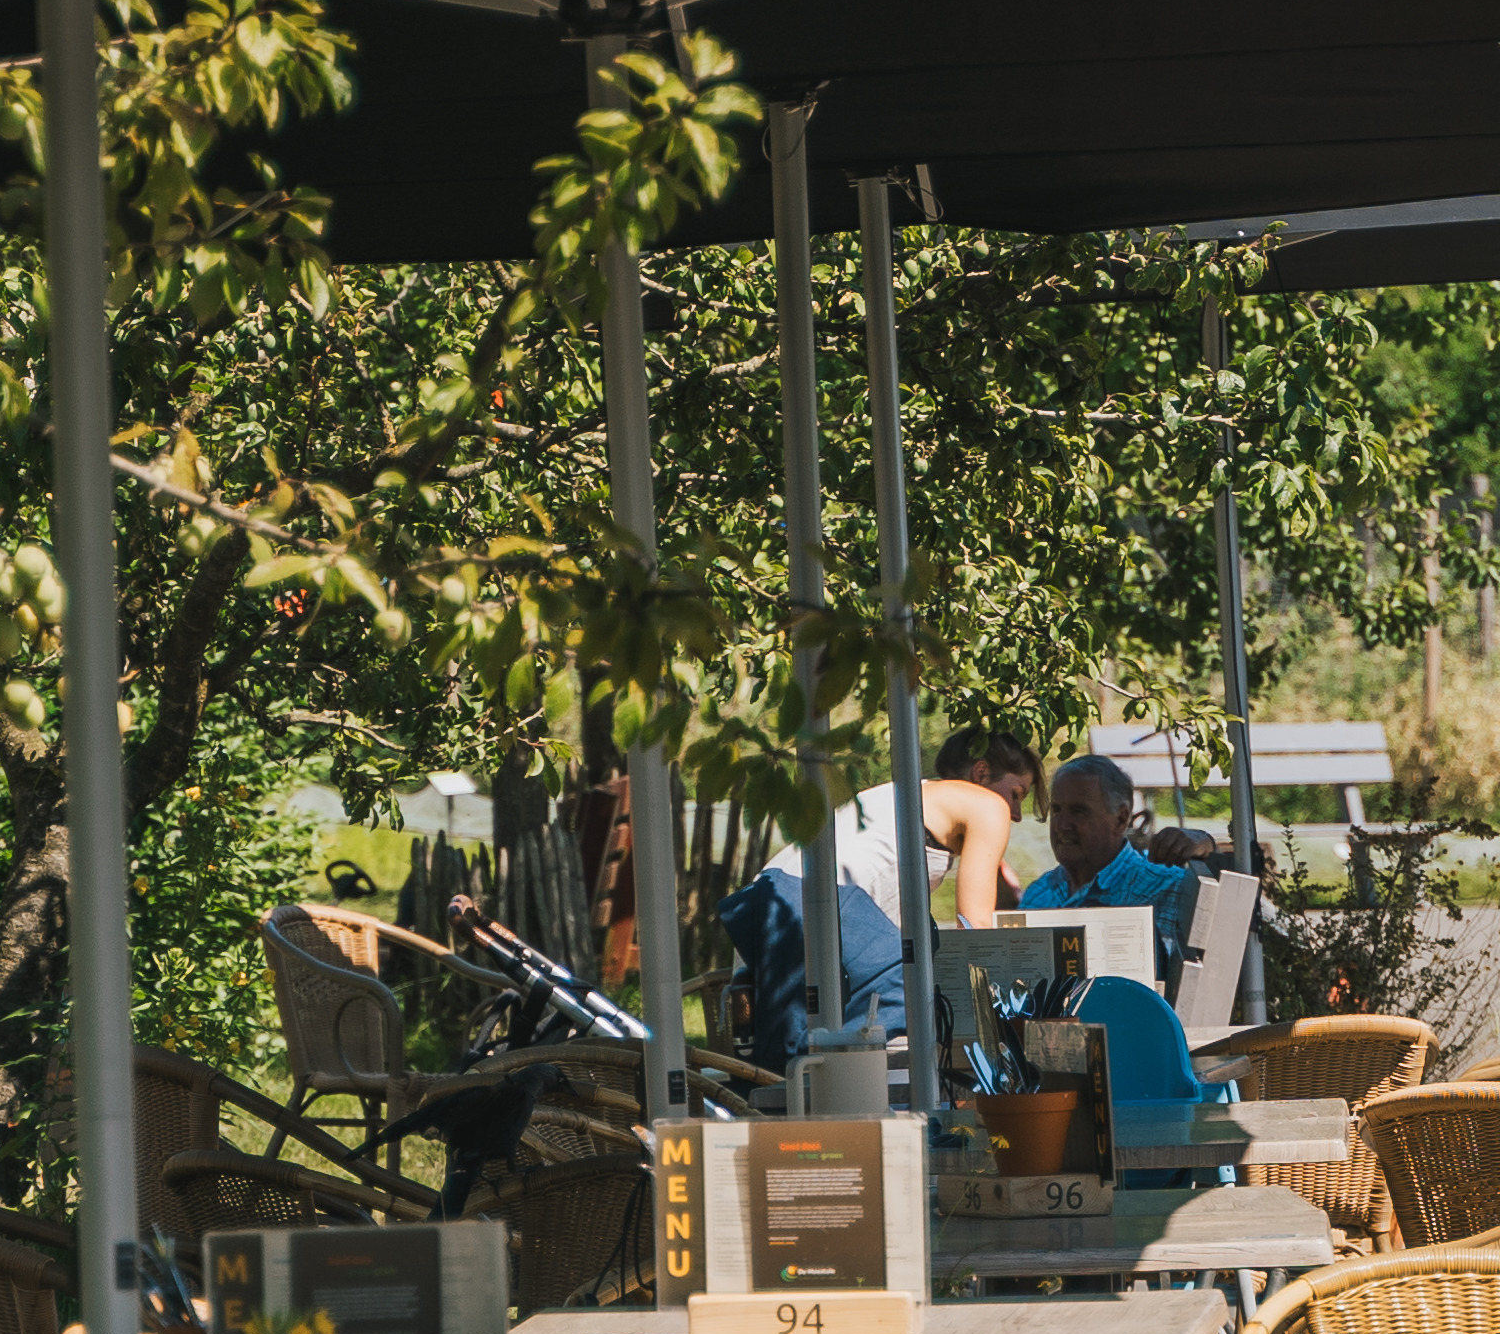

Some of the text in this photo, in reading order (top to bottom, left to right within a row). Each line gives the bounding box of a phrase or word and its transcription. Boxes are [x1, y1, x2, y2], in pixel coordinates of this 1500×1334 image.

[662, 1138, 692, 1278] MENU
[964, 1181, 981, 1210] 96
[1046, 1181, 1083, 1210] 96
